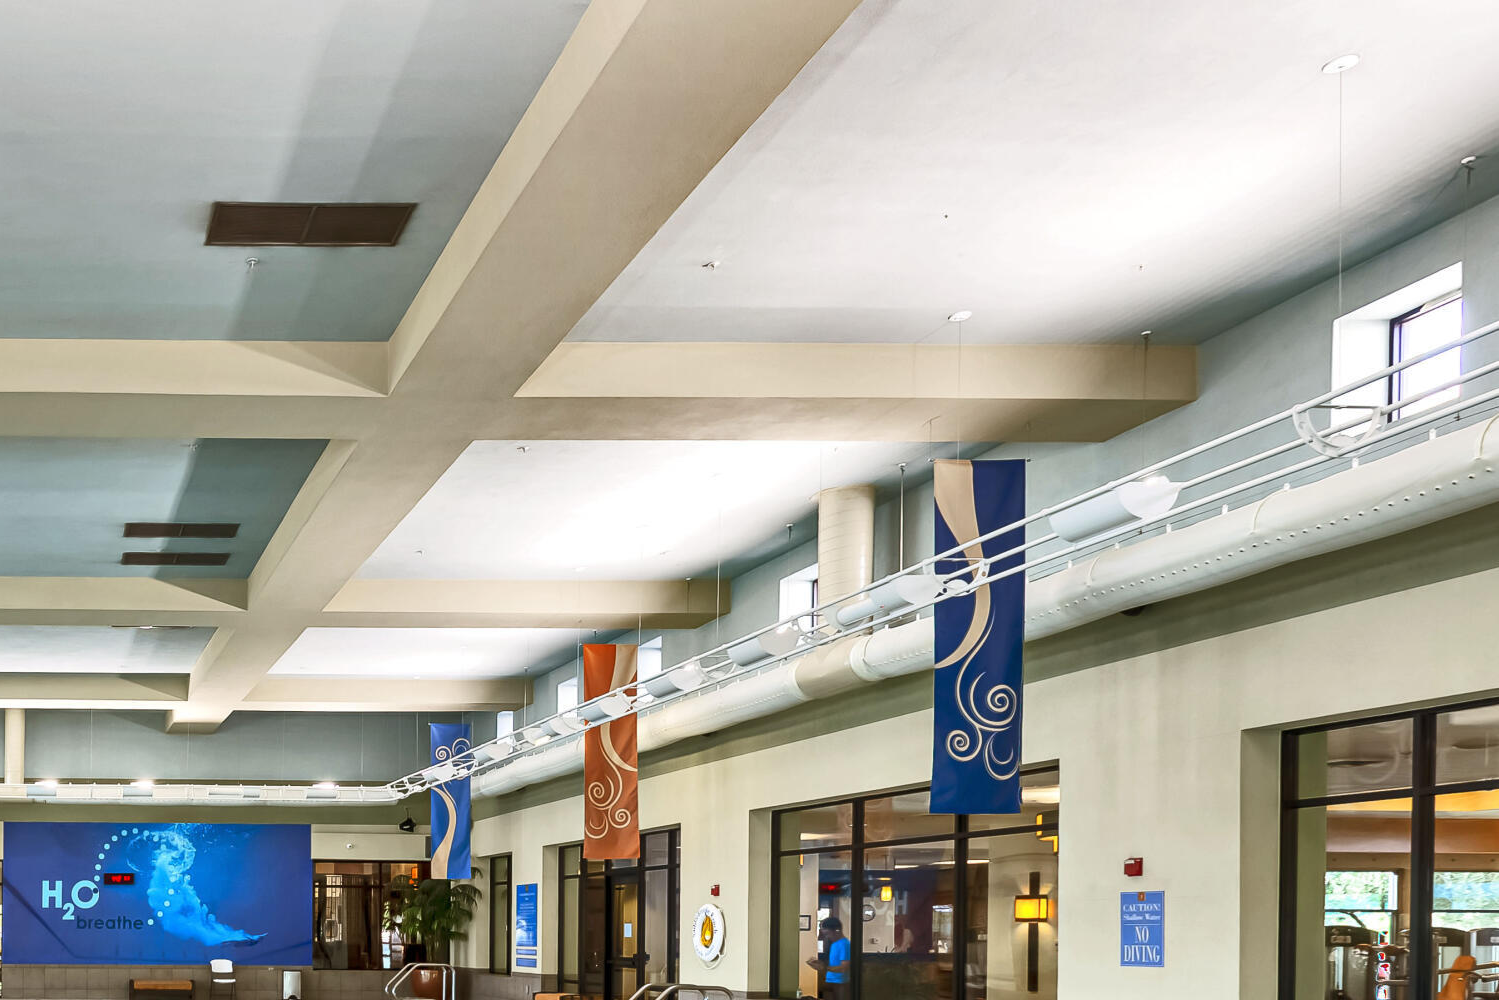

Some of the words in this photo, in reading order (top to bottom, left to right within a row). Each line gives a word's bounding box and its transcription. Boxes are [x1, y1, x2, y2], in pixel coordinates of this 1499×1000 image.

[76, 915, 144, 930] breathe
[1135, 926, 1149, 943] NO
[1124, 944, 1161, 963] DIVING
